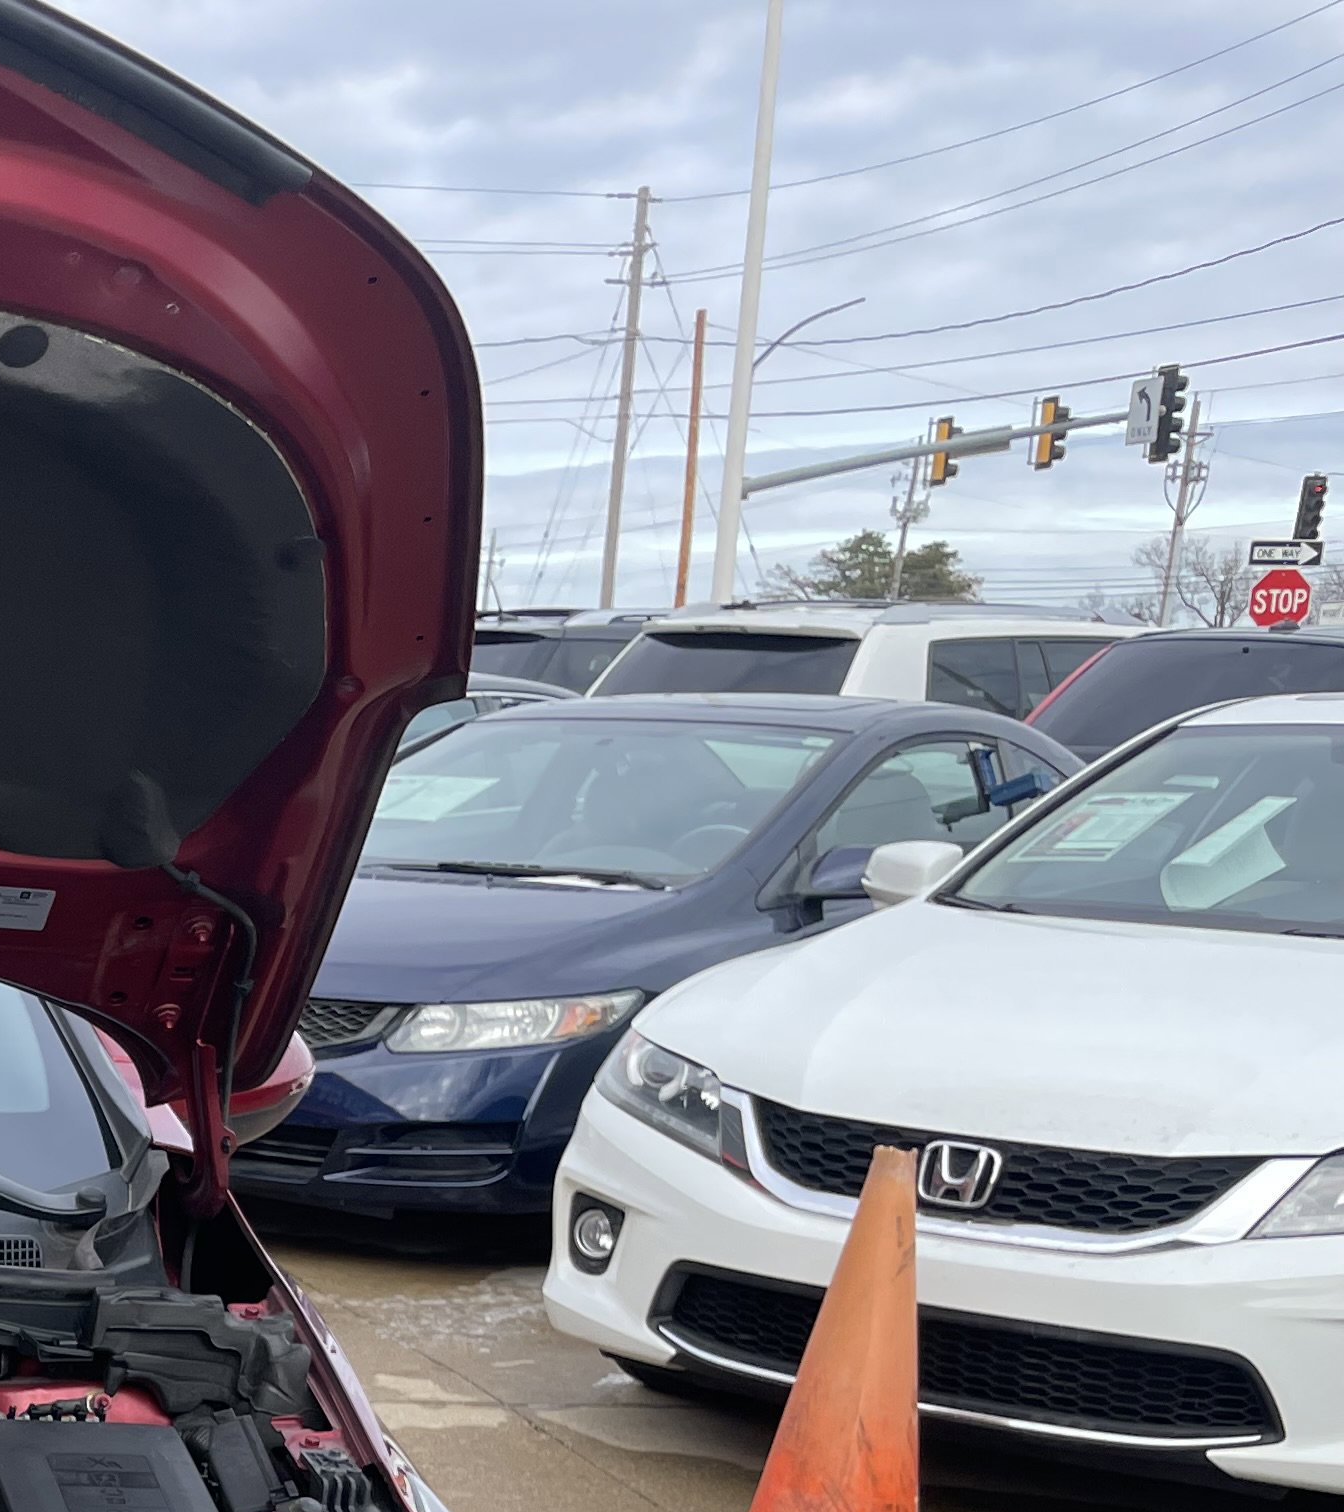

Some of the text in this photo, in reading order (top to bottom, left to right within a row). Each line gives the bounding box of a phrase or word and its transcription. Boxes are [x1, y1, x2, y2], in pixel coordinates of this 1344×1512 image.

[1130, 426, 1152, 438] ONLY
[1257, 548, 1300, 558] ONE WAY
[1253, 588, 1308, 614] STOP
